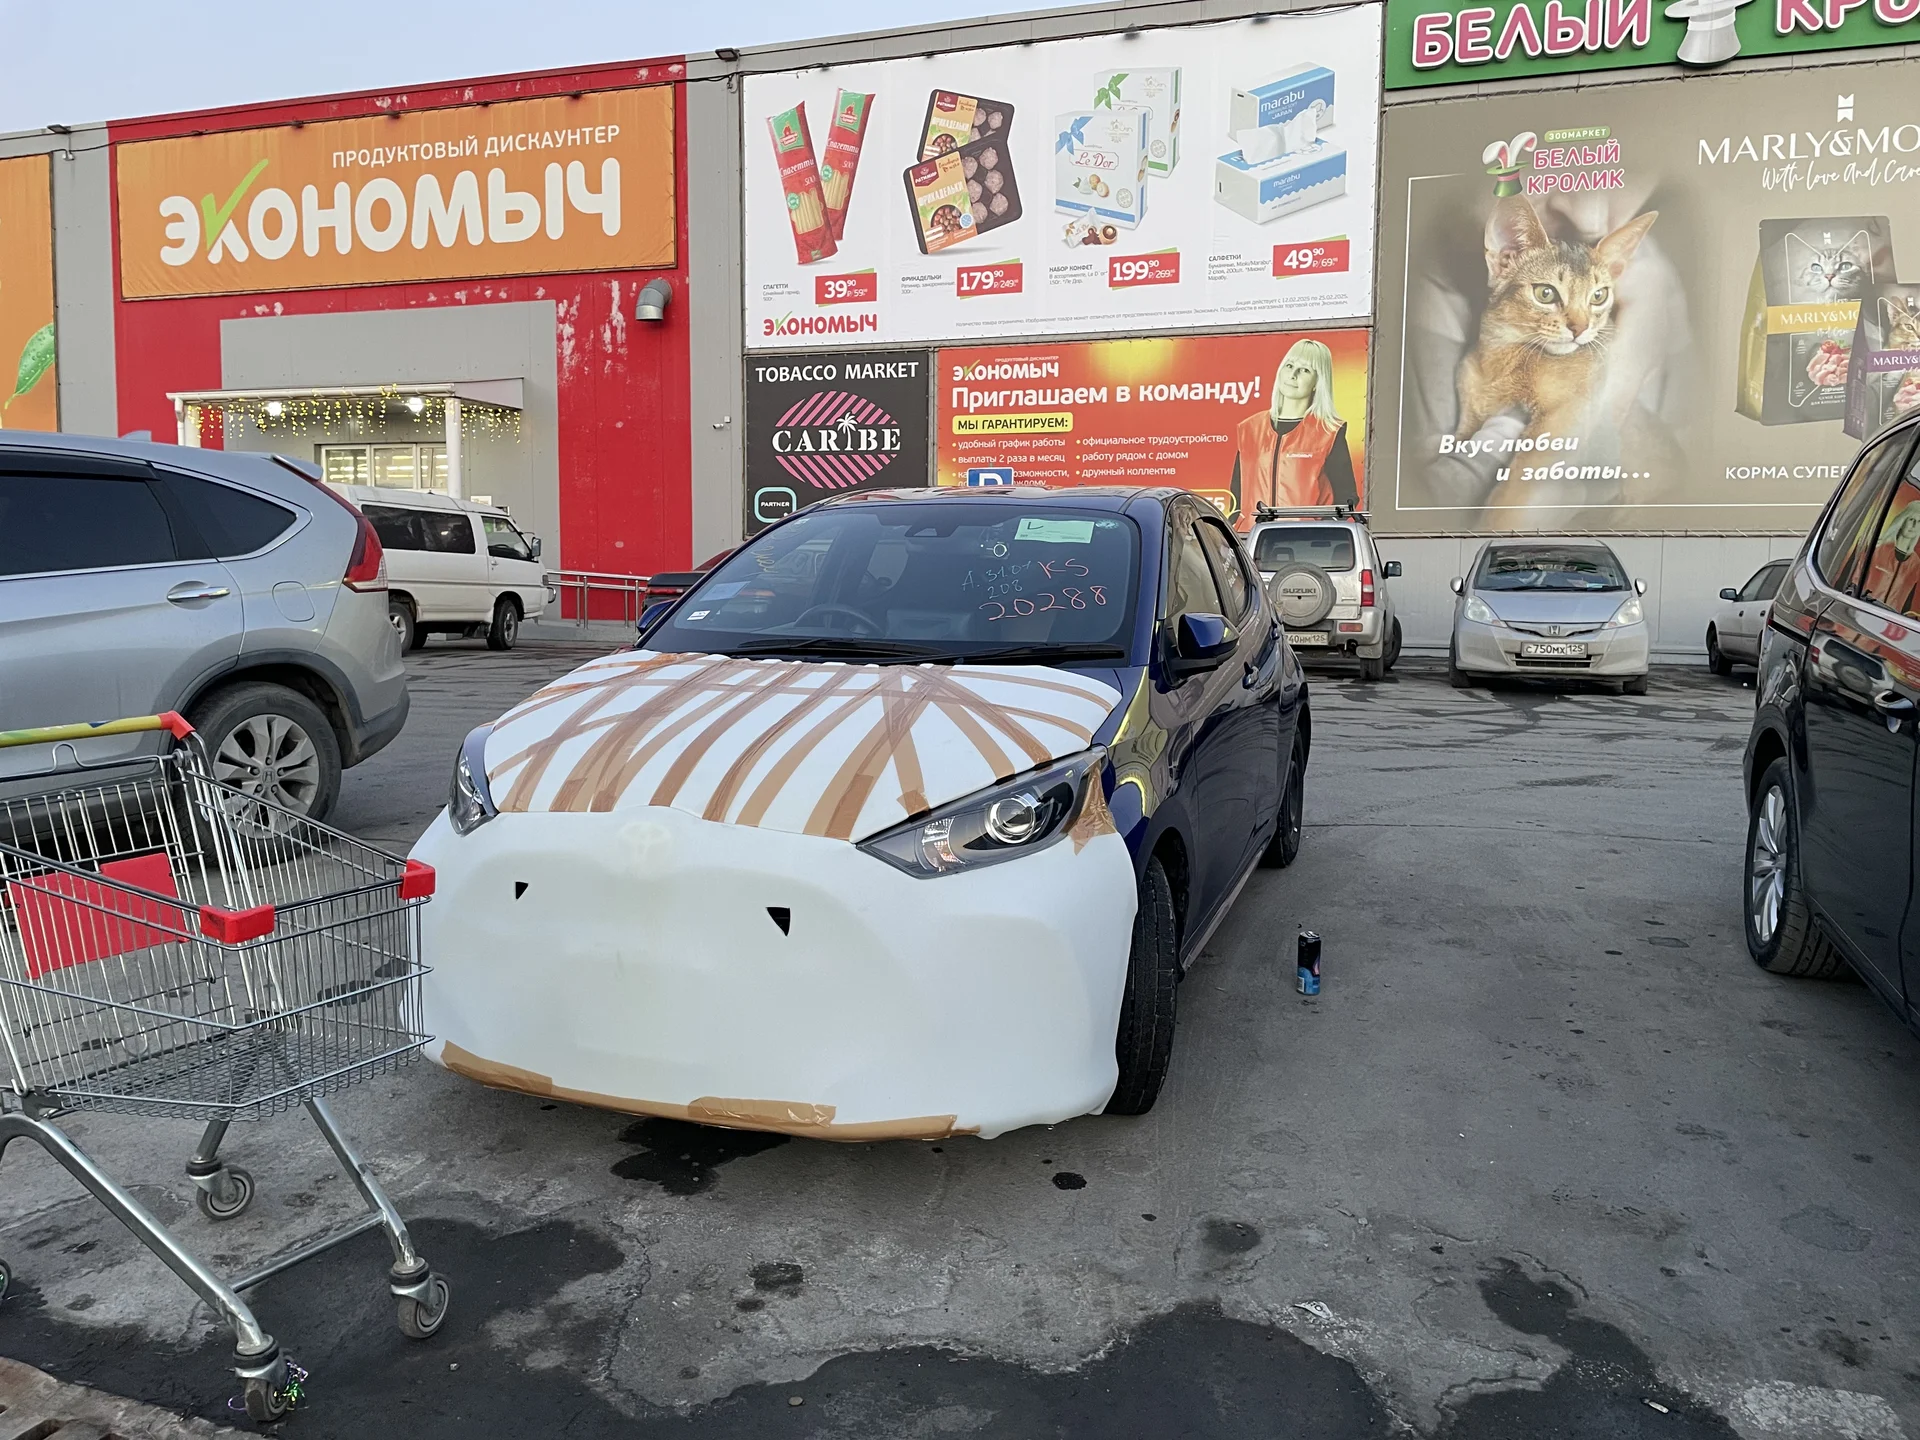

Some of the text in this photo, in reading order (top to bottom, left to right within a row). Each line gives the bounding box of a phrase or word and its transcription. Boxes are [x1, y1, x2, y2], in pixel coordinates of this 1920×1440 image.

[1261, 90, 1305, 113] marabu
[1548, 128, 1607, 140] ЗООМАРКЕТ
[332, 124, 620, 169] ПРОДУКТОВЫЙ ДИСКАУНТЕР
[1534, 139, 1621, 169] БЕЛЫЙ
[1075, 152, 1091, 166] Le
[1273, 173, 1301, 187] marabu
[1526, 169, 1625, 195] КРОЛИК
[1762, 161, 1804, 192] With
[1806, 160, 1840, 191] love
[159, 157, 621, 267] ЭКОНОМЫЧ
[1208, 254, 1242, 262] САЛФЕТКИ
[1283, 248, 1313, 269] 49
[901, 274, 942, 282] ФРИКАДЕЛЬКИ
[960, 270, 994, 291] 179
[1112, 260, 1149, 281] 199
[824, 280, 847, 299] 39
[763, 311, 877, 336] ЭКОНОМЫЧ
[952, 359, 1059, 381] ЭКОНОМЫЧ
[1873, 355, 1920, 366] MARLY&
[755, 362, 919, 382] TOBACCO MARKET
[952, 375, 1261, 413] Приглашаем в команду!
[772, 412, 900, 452] CARIBE
[958, 417, 1068, 430] МЫ ГАРАНТИРУЕМ:
[958, 438, 1065, 451] удобный график работы
[1082, 433, 1229, 447] официальное трудоустройство
[1438, 432, 1579, 458] Вкус любви
[999, 454, 1005, 463] 2
[1007, 456, 1027, 464] раза
[1037, 454, 1065, 463] месяц
[1082, 451, 1188, 462] работу рядом с домом
[1013, 469, 1070, 478] озможности,
[1081, 466, 1176, 478] дружный коллектив
[1495, 461, 1651, 481] и заботы...
[1725, 466, 1789, 480] КОРМА
[1037, 558, 1089, 579] KS
[987, 580, 1023, 600] 208
[978, 585, 1108, 621] 20288
[1567, 645, 1583, 653] 125
